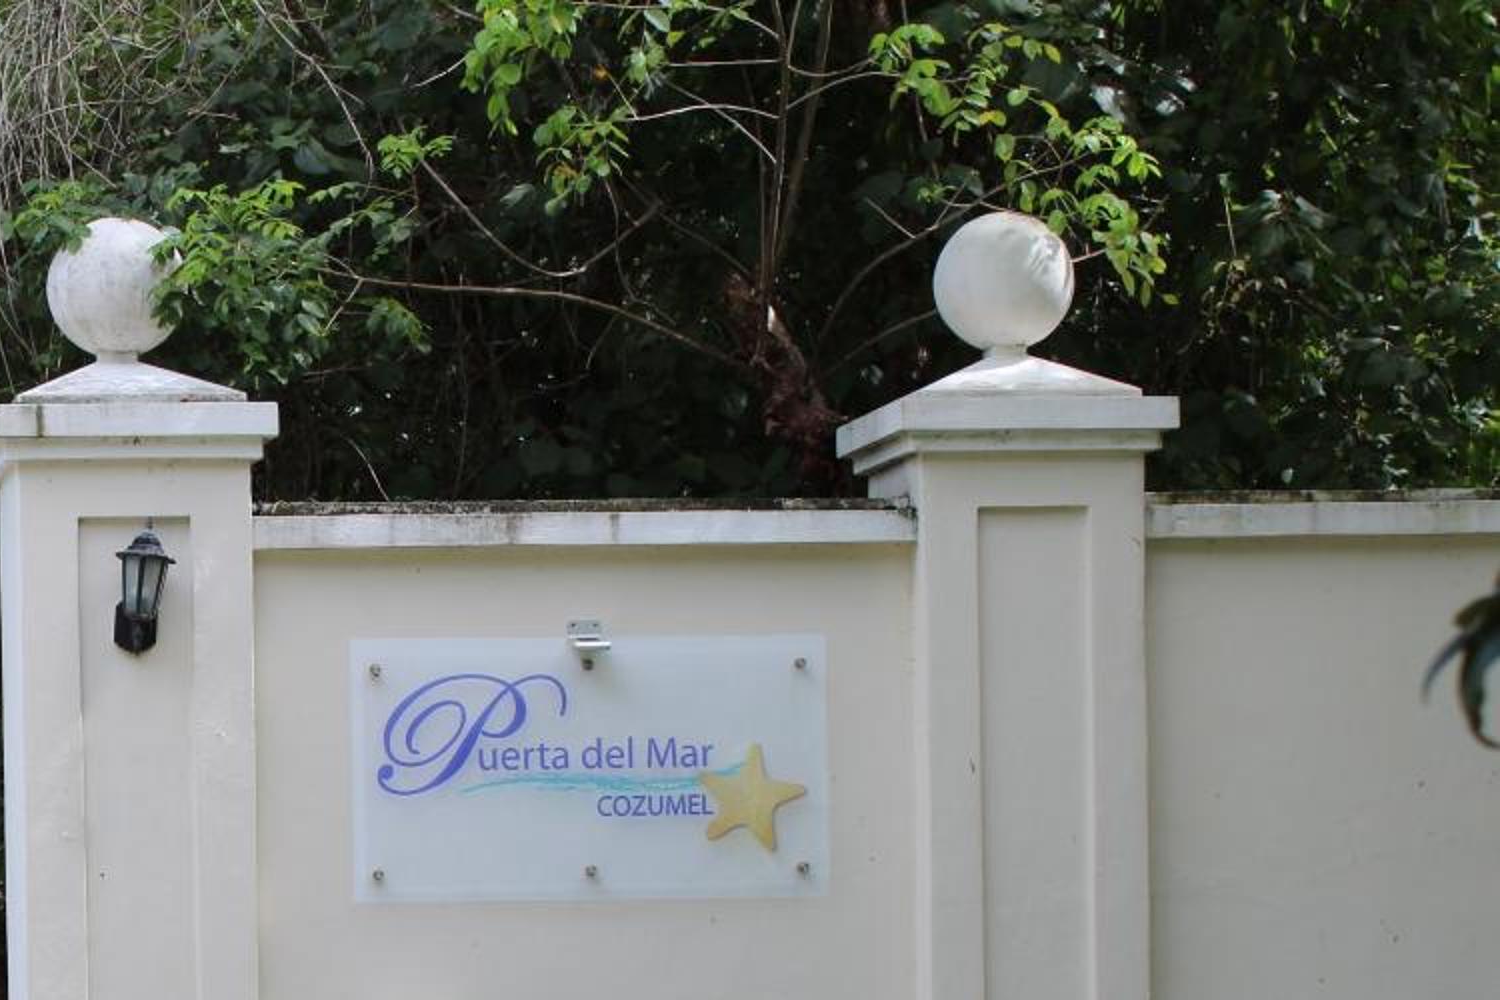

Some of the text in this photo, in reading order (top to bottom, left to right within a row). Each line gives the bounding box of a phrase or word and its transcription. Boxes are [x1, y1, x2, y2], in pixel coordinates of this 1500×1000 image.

[377, 674, 714, 796] Puerta del Mar
[597, 794, 714, 817] COZUMEL
